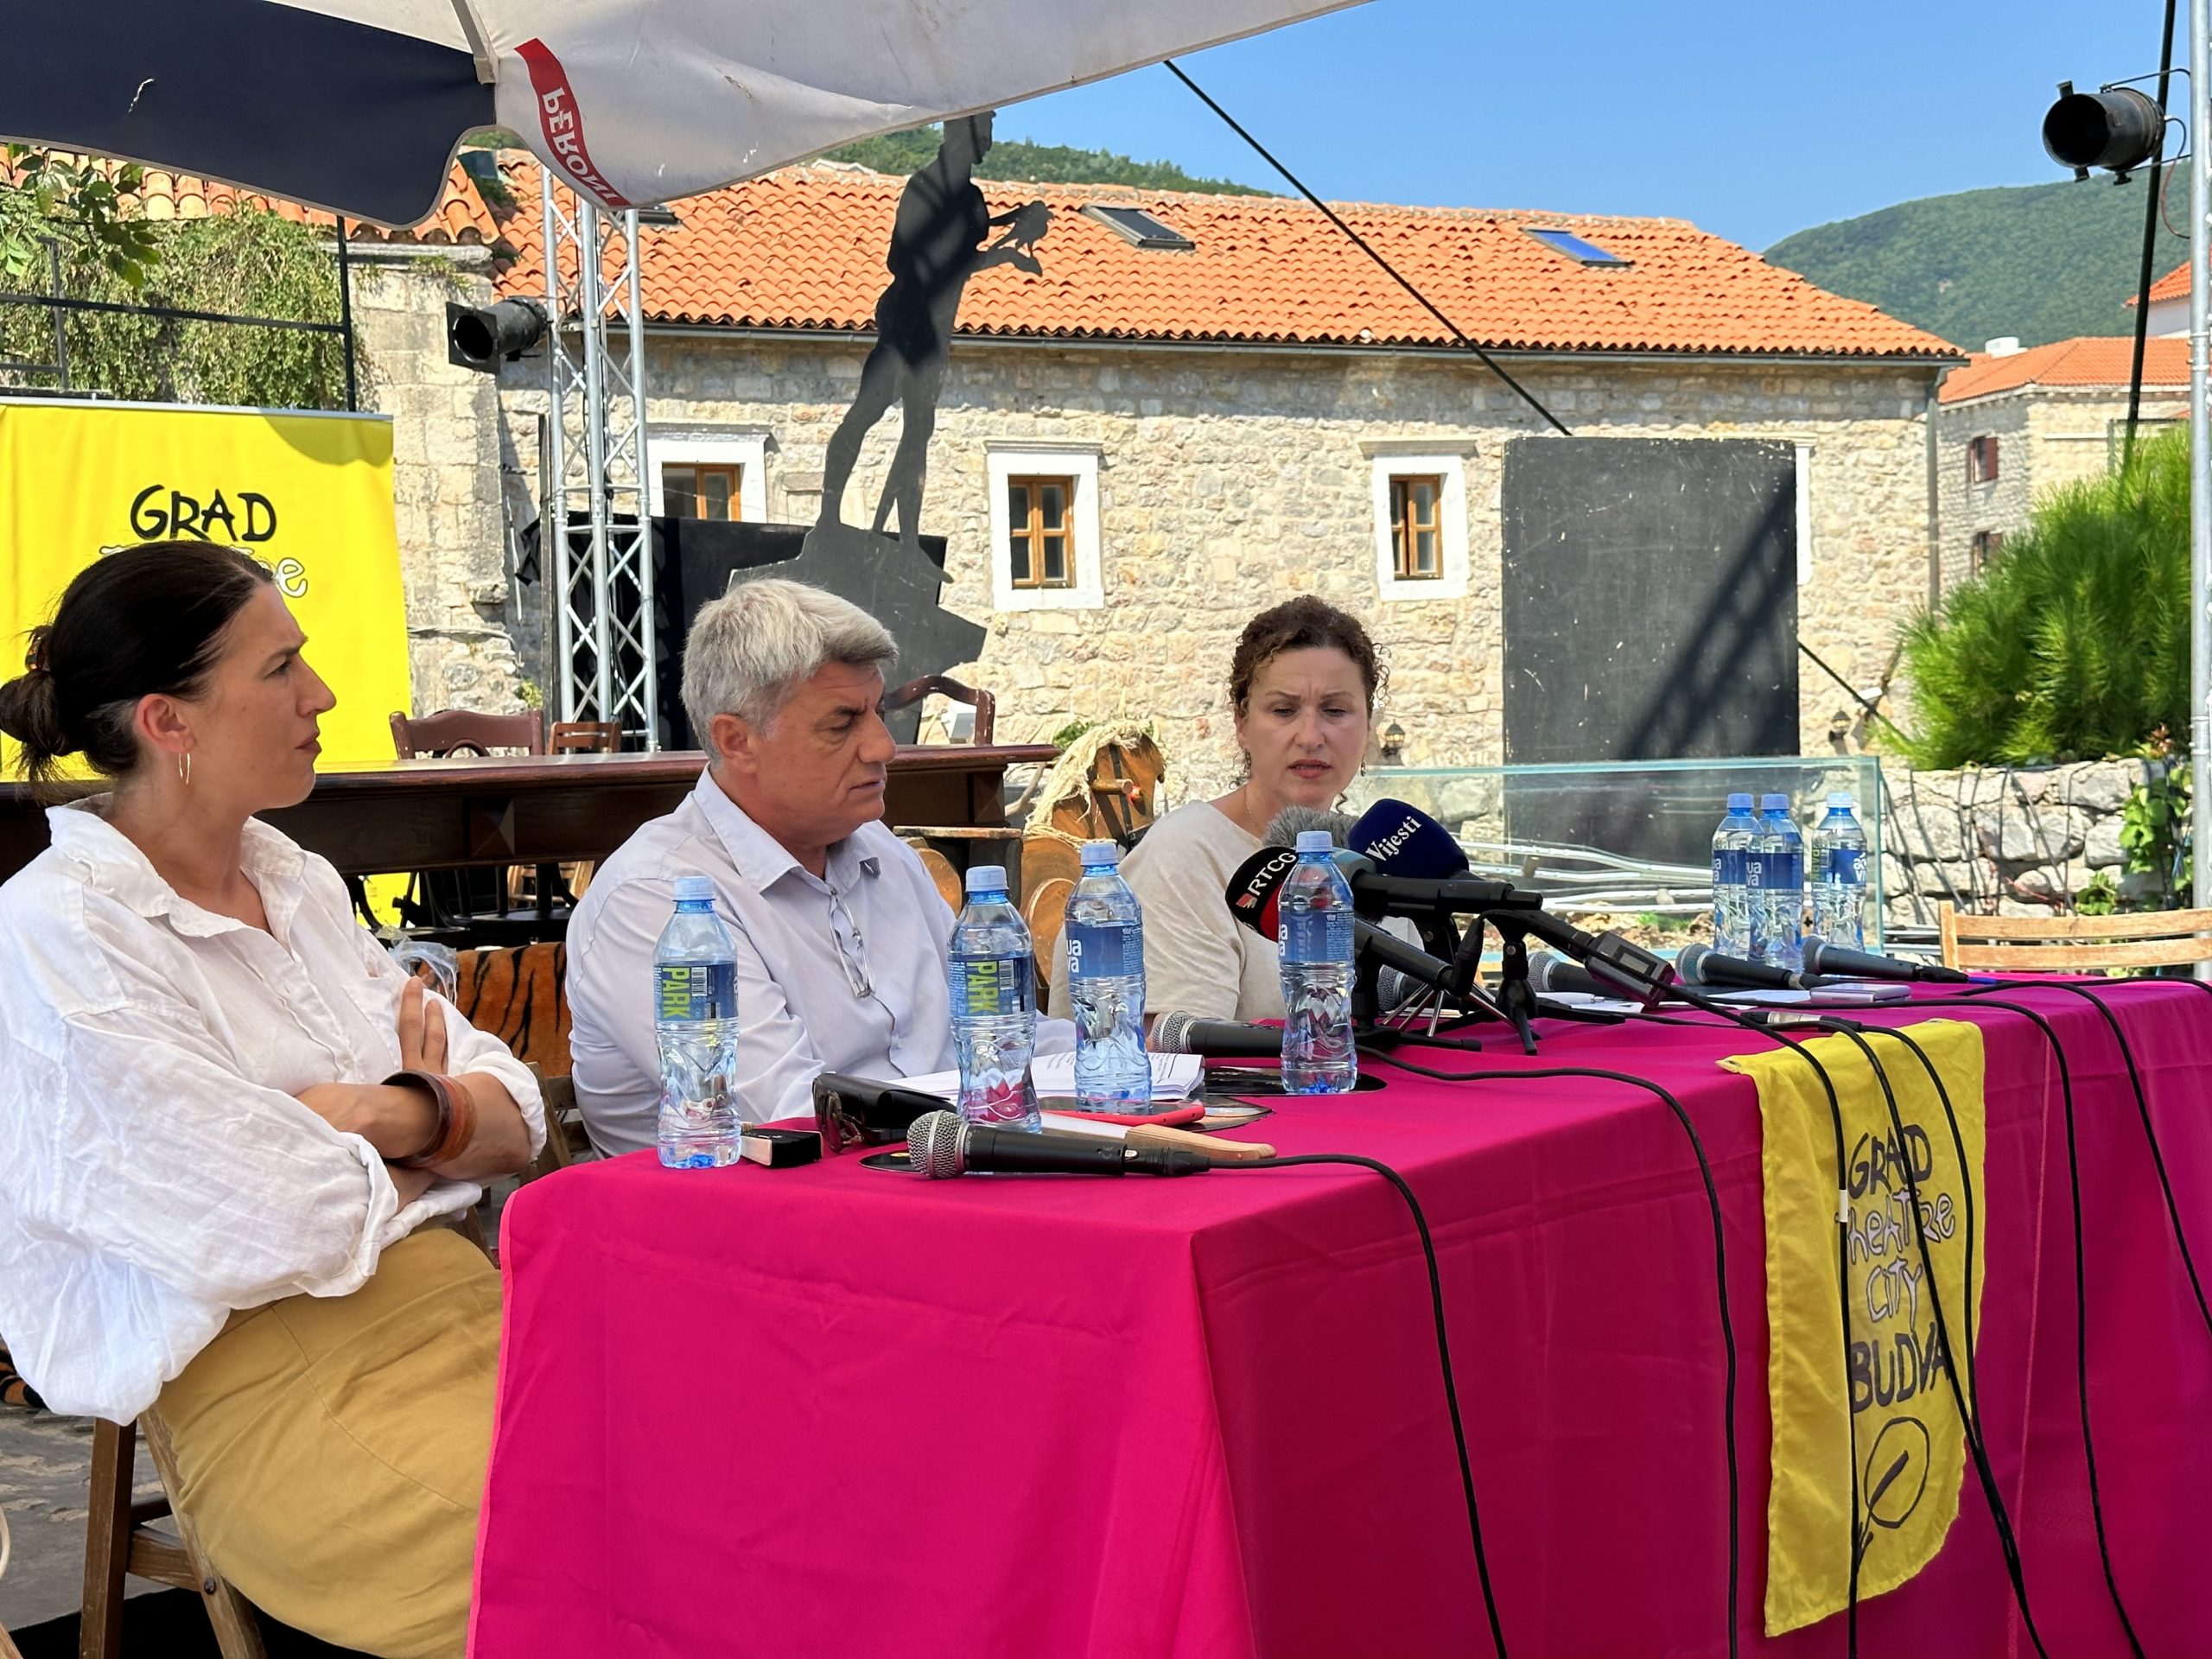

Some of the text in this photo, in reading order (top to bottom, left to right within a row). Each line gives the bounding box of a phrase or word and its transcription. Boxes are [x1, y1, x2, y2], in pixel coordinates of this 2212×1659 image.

[130, 484, 277, 542] GRAD
[1365, 816, 1422, 861] Vijesti
[1248, 852, 1296, 896] RTCG
[662, 967, 691, 1019] PARK
[966, 961, 1000, 1014] PARK
[1847, 1124, 1933, 1199] GRAD
[1850, 1321, 1950, 1414] BUDVA
